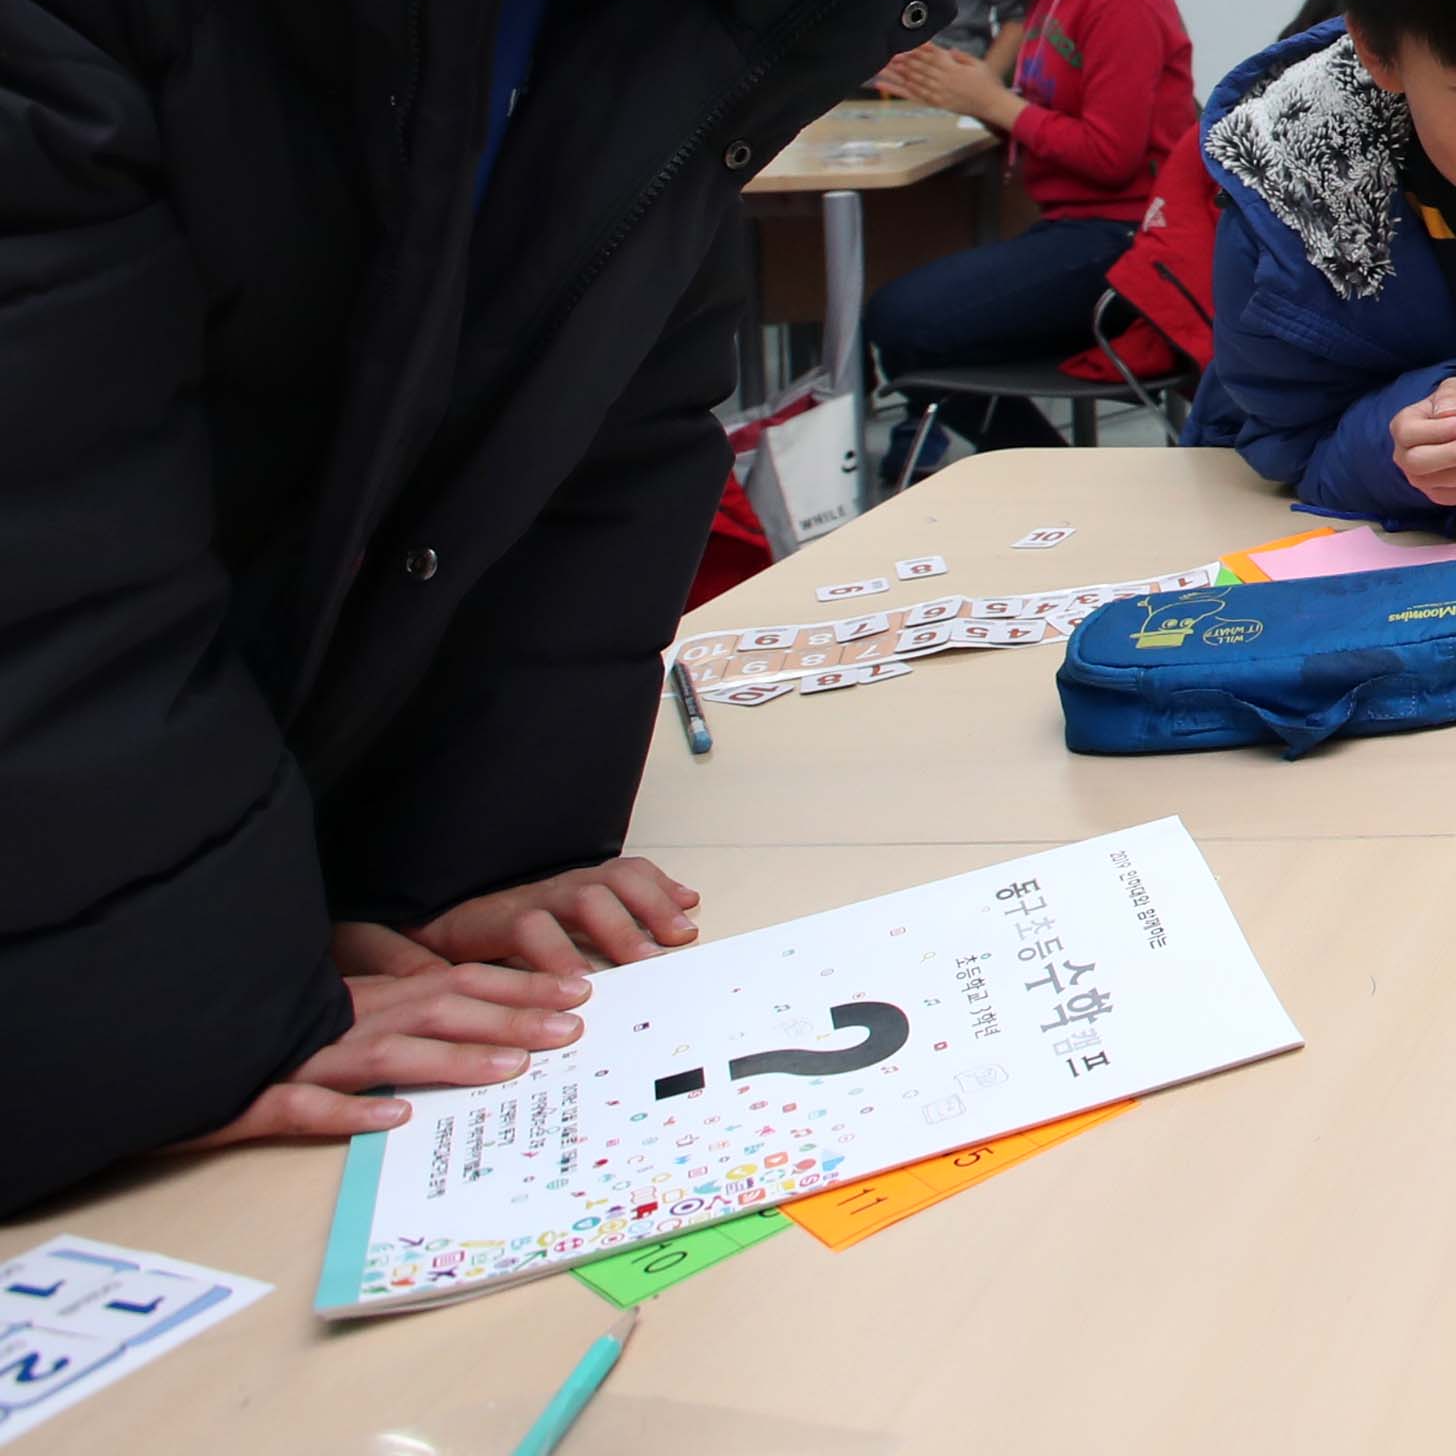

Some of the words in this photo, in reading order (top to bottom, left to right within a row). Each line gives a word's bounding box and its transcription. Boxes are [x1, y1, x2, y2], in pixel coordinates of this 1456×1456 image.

[1031, 530, 1067, 542] 10
[911, 564, 931, 574] 8
[1076, 593, 1100, 604] 3
[986, 602, 1008, 613] 5
[1035, 603, 1058, 615] 4
[966, 627, 989, 638] 5
[1008, 628, 1032, 639] 4
[808, 633, 833, 645] 8
[1218, 635, 1244, 644] WILL
[683, 645, 734, 662] 10
[801, 654, 826, 665] 8
[816, 673, 843, 686] 8
[728, 686, 778, 702] 10
[1110, 850, 1132, 869] 2019
[1119, 869, 1151, 909] 인하대와
[1137, 908, 1168, 950] 함께하는
[955, 953, 989, 1004] 초등학교
[970, 1005, 1001, 1039] 3학년
[837, 1187, 888, 1216] 11
[631, 1243, 688, 1274] 10
